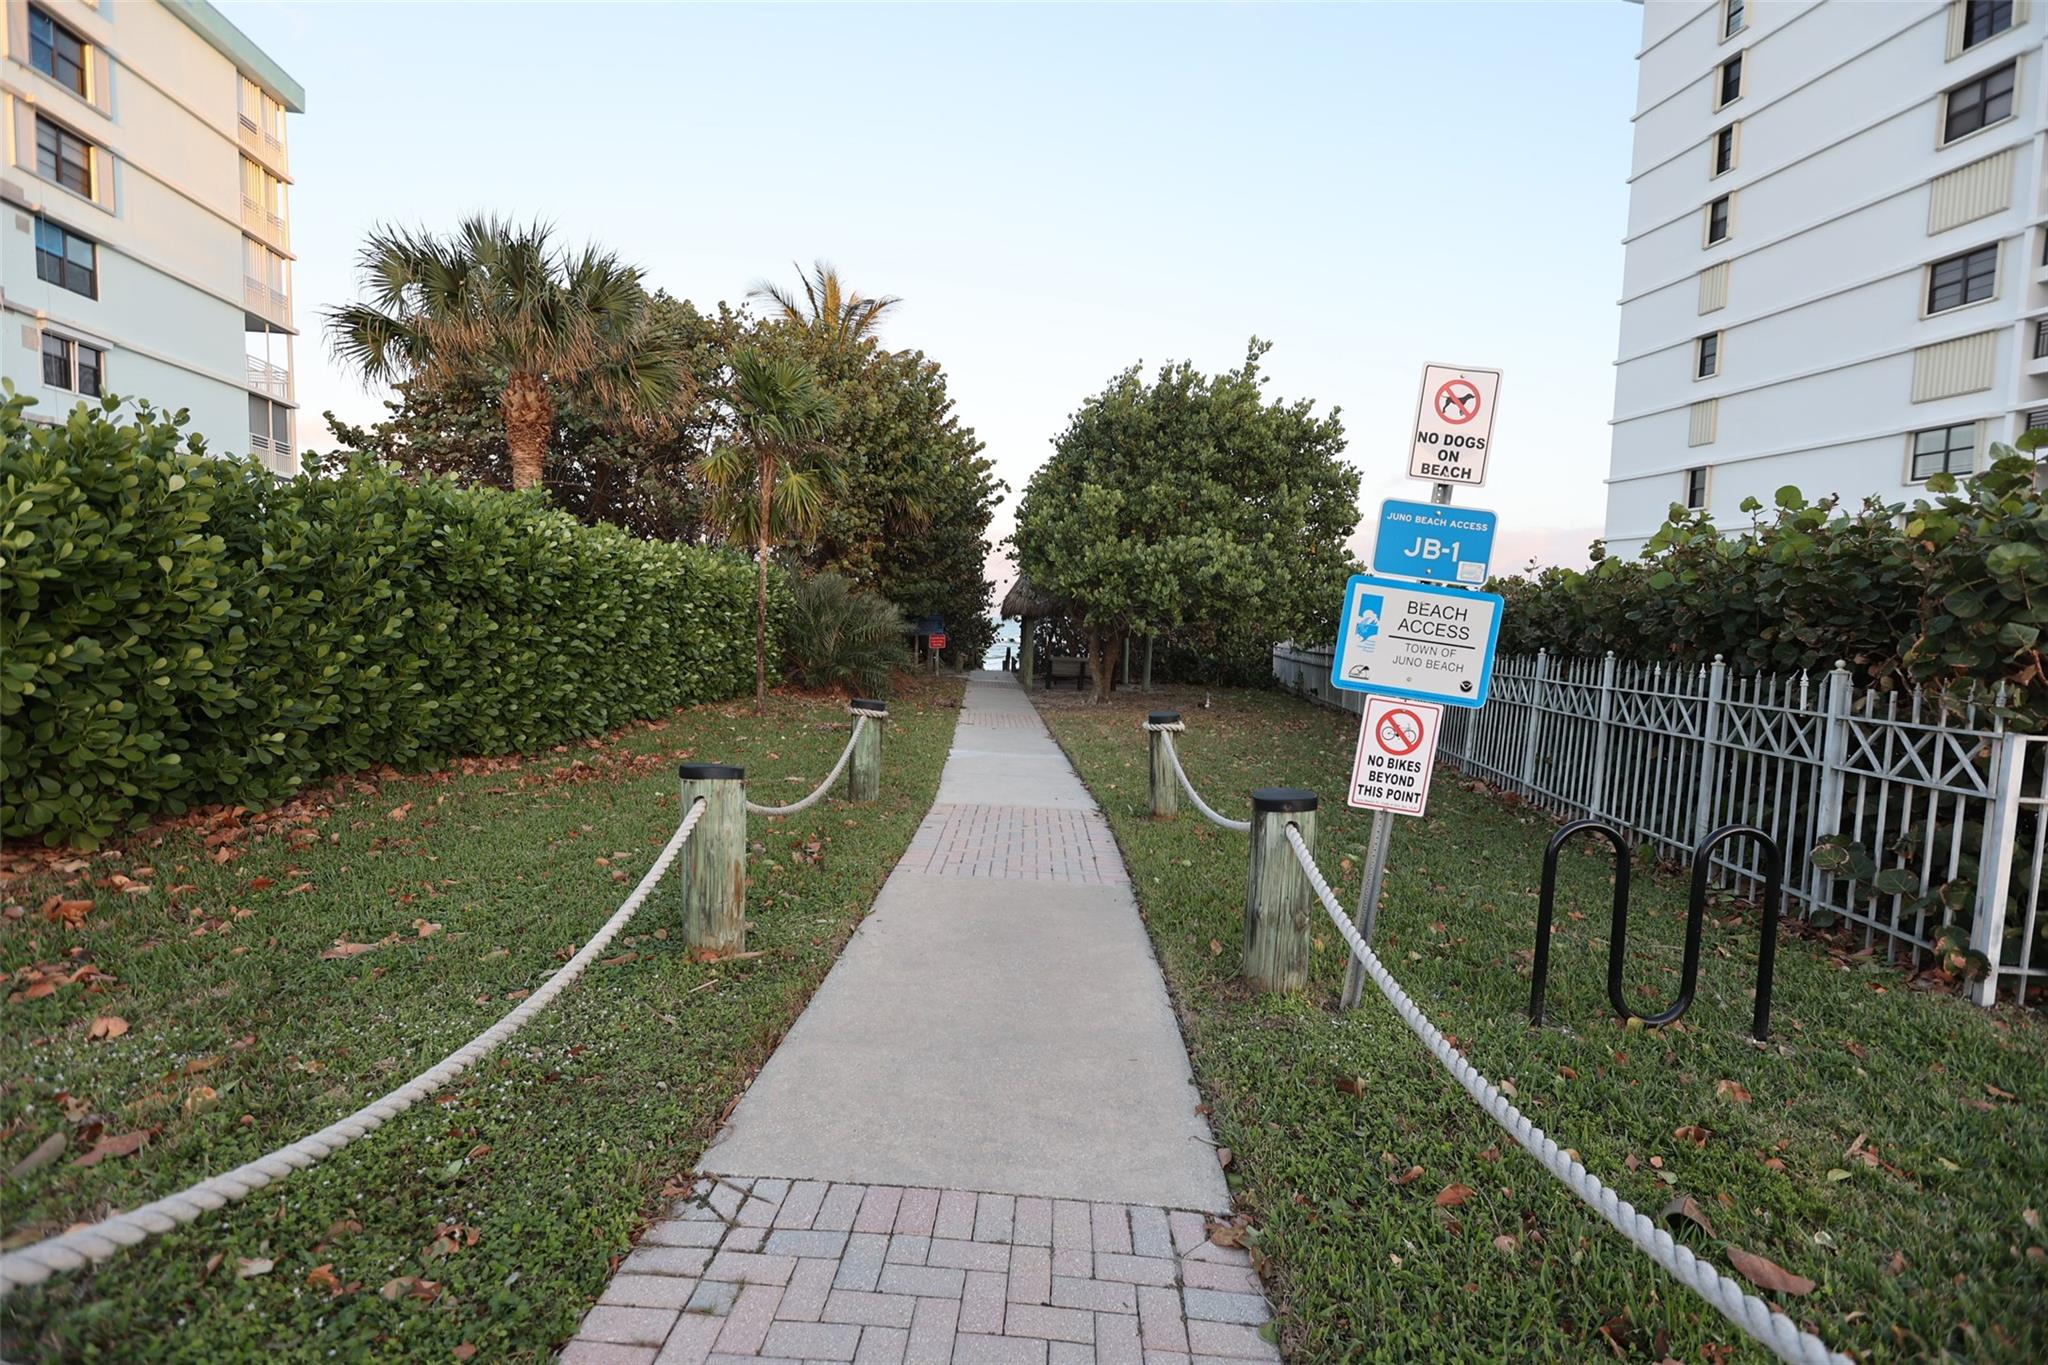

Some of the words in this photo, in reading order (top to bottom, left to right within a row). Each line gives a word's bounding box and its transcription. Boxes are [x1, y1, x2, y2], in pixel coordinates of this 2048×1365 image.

[1417, 431, 1439, 444] NO
[1443, 434, 1486, 449] DOGS
[1437, 449, 1460, 462] ON
[1421, 463, 1472, 479] BEACH
[1386, 512, 1412, 522] JUNO
[1415, 515, 1447, 526] BEACH
[1449, 520, 1488, 532] ACCESS
[1404, 537, 1460, 562] JB-1
[1407, 600, 1468, 622] BEACH
[1397, 618, 1470, 640] ACCESS
[1404, 642, 1438, 658] TOWN
[1441, 646, 1457, 658] OF
[1392, 655, 1423, 668] JUNO
[1425, 659, 1465, 673] BEACH
[1367, 754, 1384, 767] NO
[1387, 758, 1421, 773] BIKES
[1368, 770, 1415, 787] BEYOND
[1357, 784, 1383, 798] THIS
[1386, 788, 1421, 804] POINT
